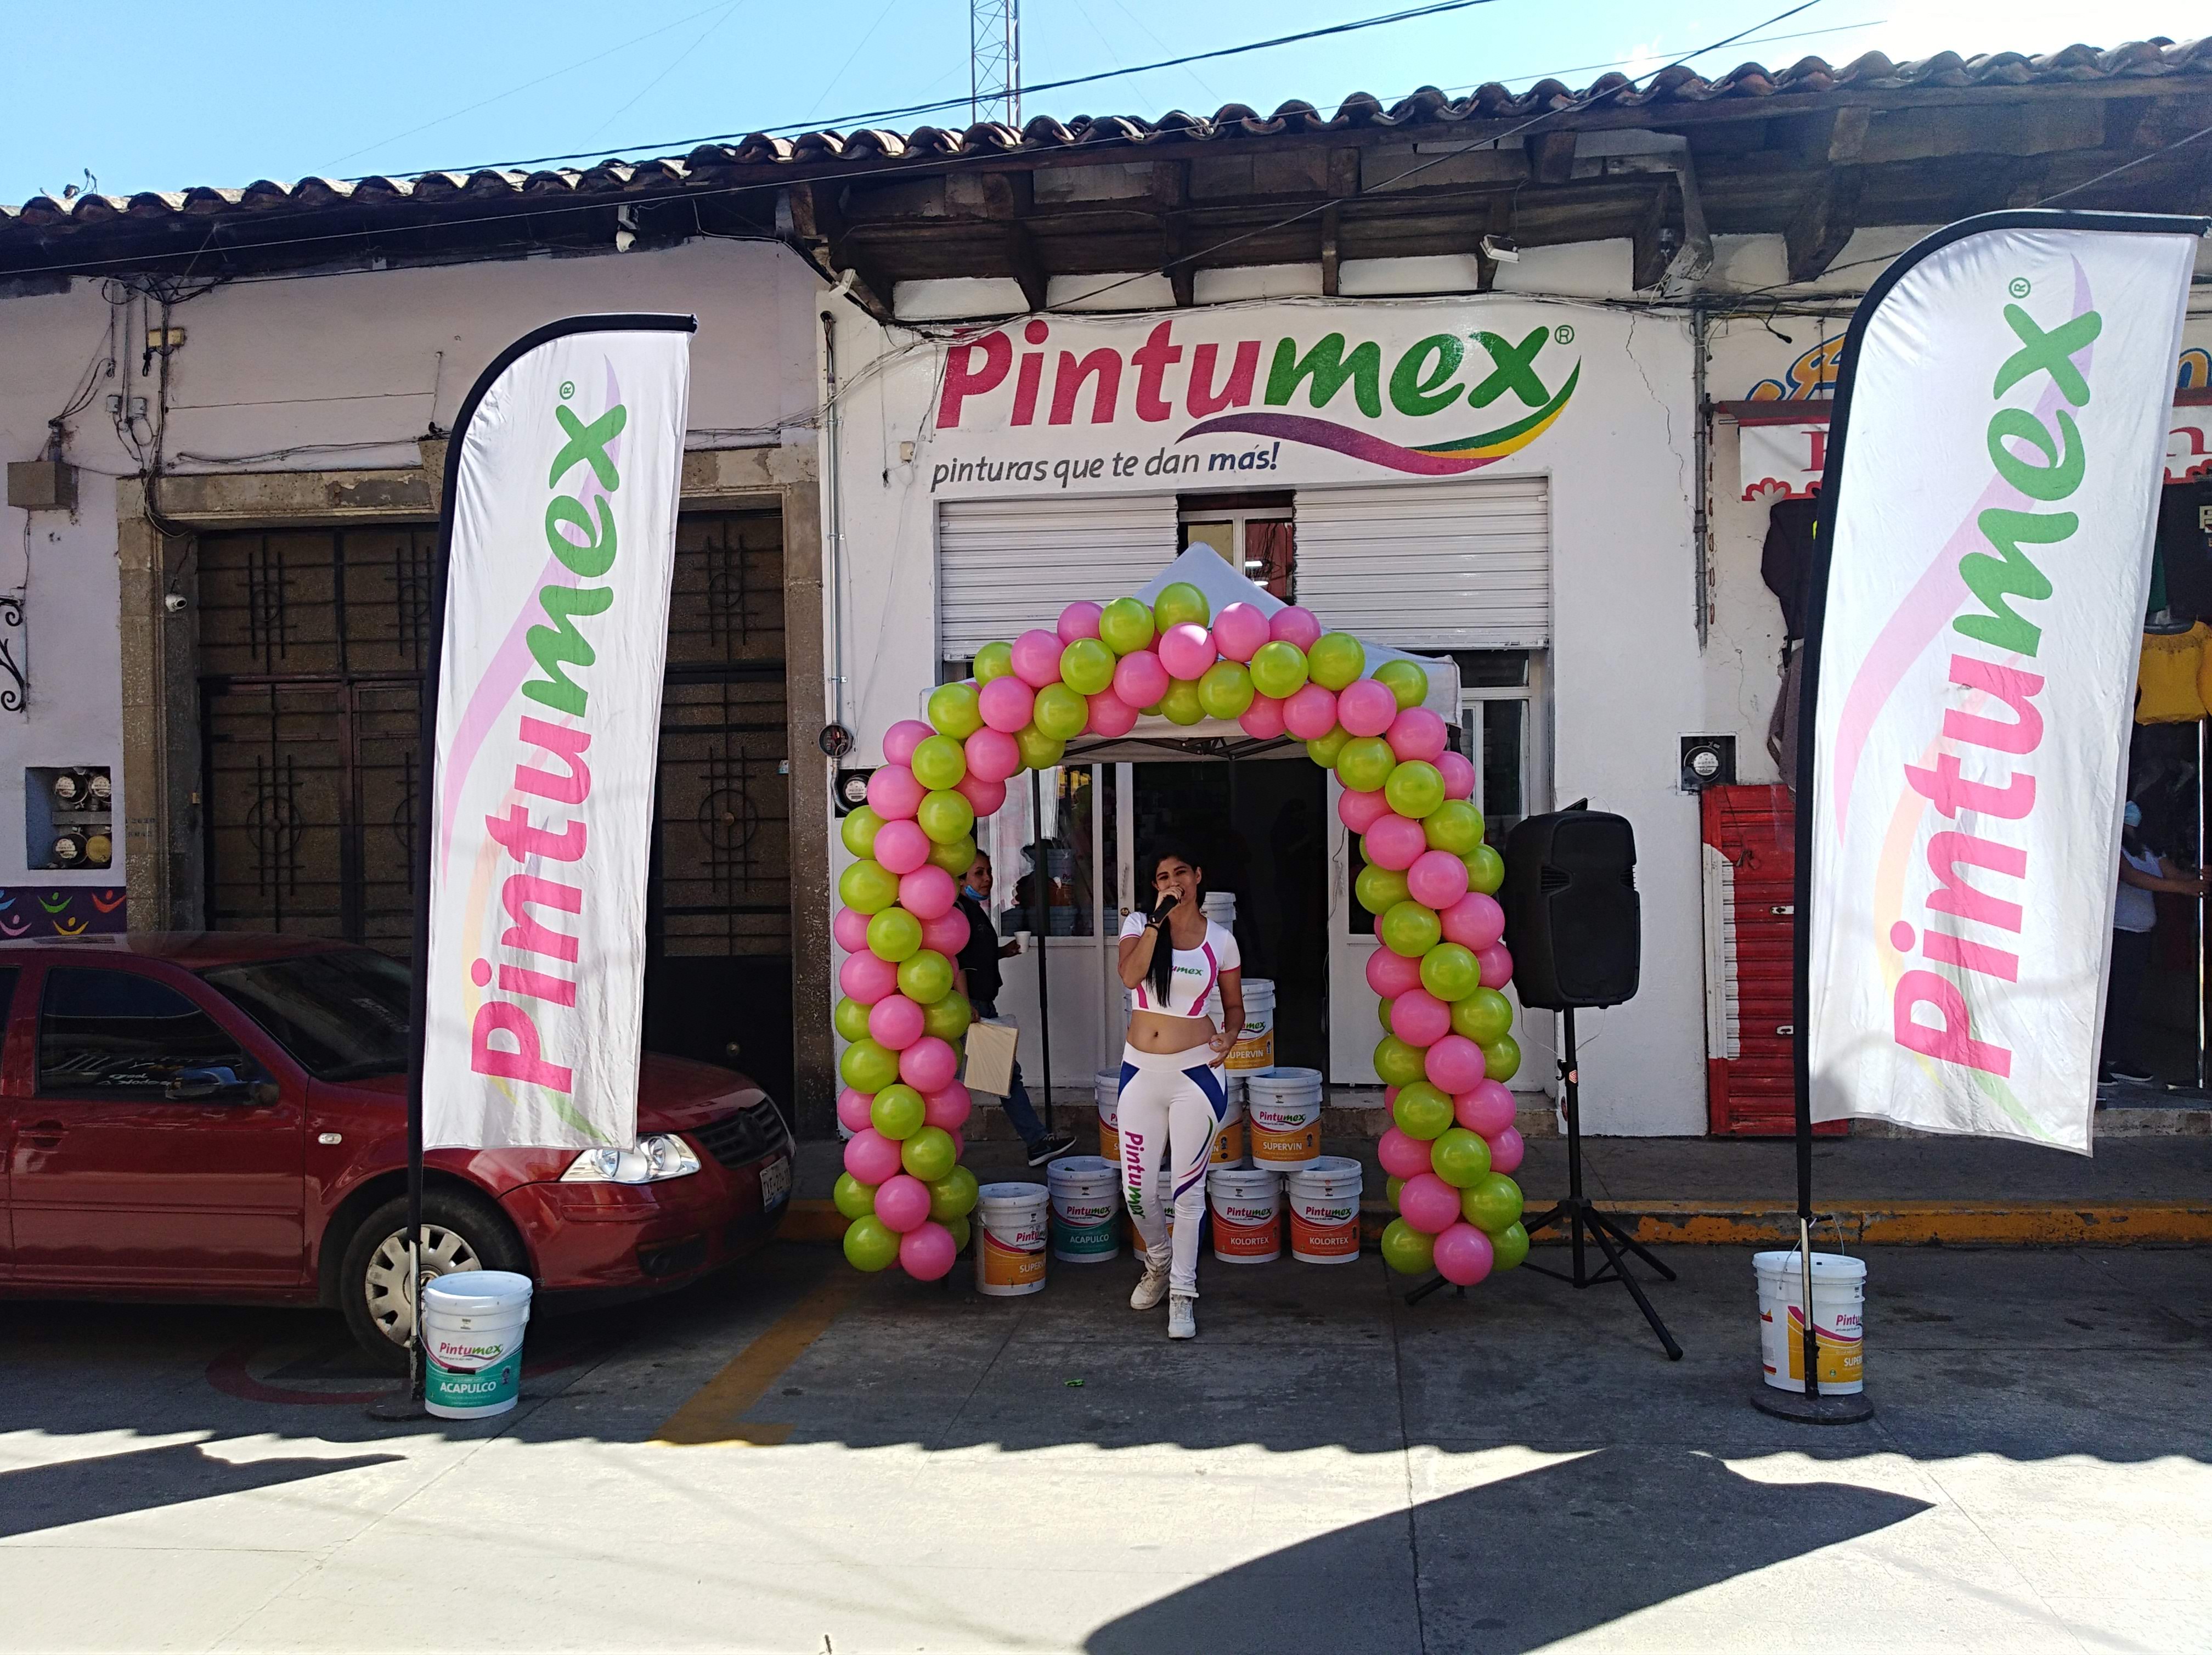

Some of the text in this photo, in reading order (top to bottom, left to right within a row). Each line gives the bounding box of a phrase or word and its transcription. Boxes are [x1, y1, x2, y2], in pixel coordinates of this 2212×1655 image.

[935, 319, 1551, 429] Pintumex
[930, 442, 1280, 493] pinturas que te dan más!
[1889, 303, 2102, 1079] Pintumex
[471, 404, 627, 1094] Pintumex
[1259, 1111, 1306, 1123] Pintumex
[1262, 1141, 1302, 1151] SUPERVIN
[1125, 1130, 1146, 1218] Pintumex
[1066, 1206, 1111, 1215] Pintumex
[1226, 1206, 1272, 1217] Pintumex
[1305, 1206, 1352, 1217] Pintumex
[1070, 1234, 1109, 1243] ACAPULCO
[1230, 1236, 1269, 1245] KOLORTEX
[1309, 1236, 1348, 1245] KOLORTEX
[440, 1343, 501, 1355] Pintumex
[440, 1382, 496, 1393] ACAPULCO
